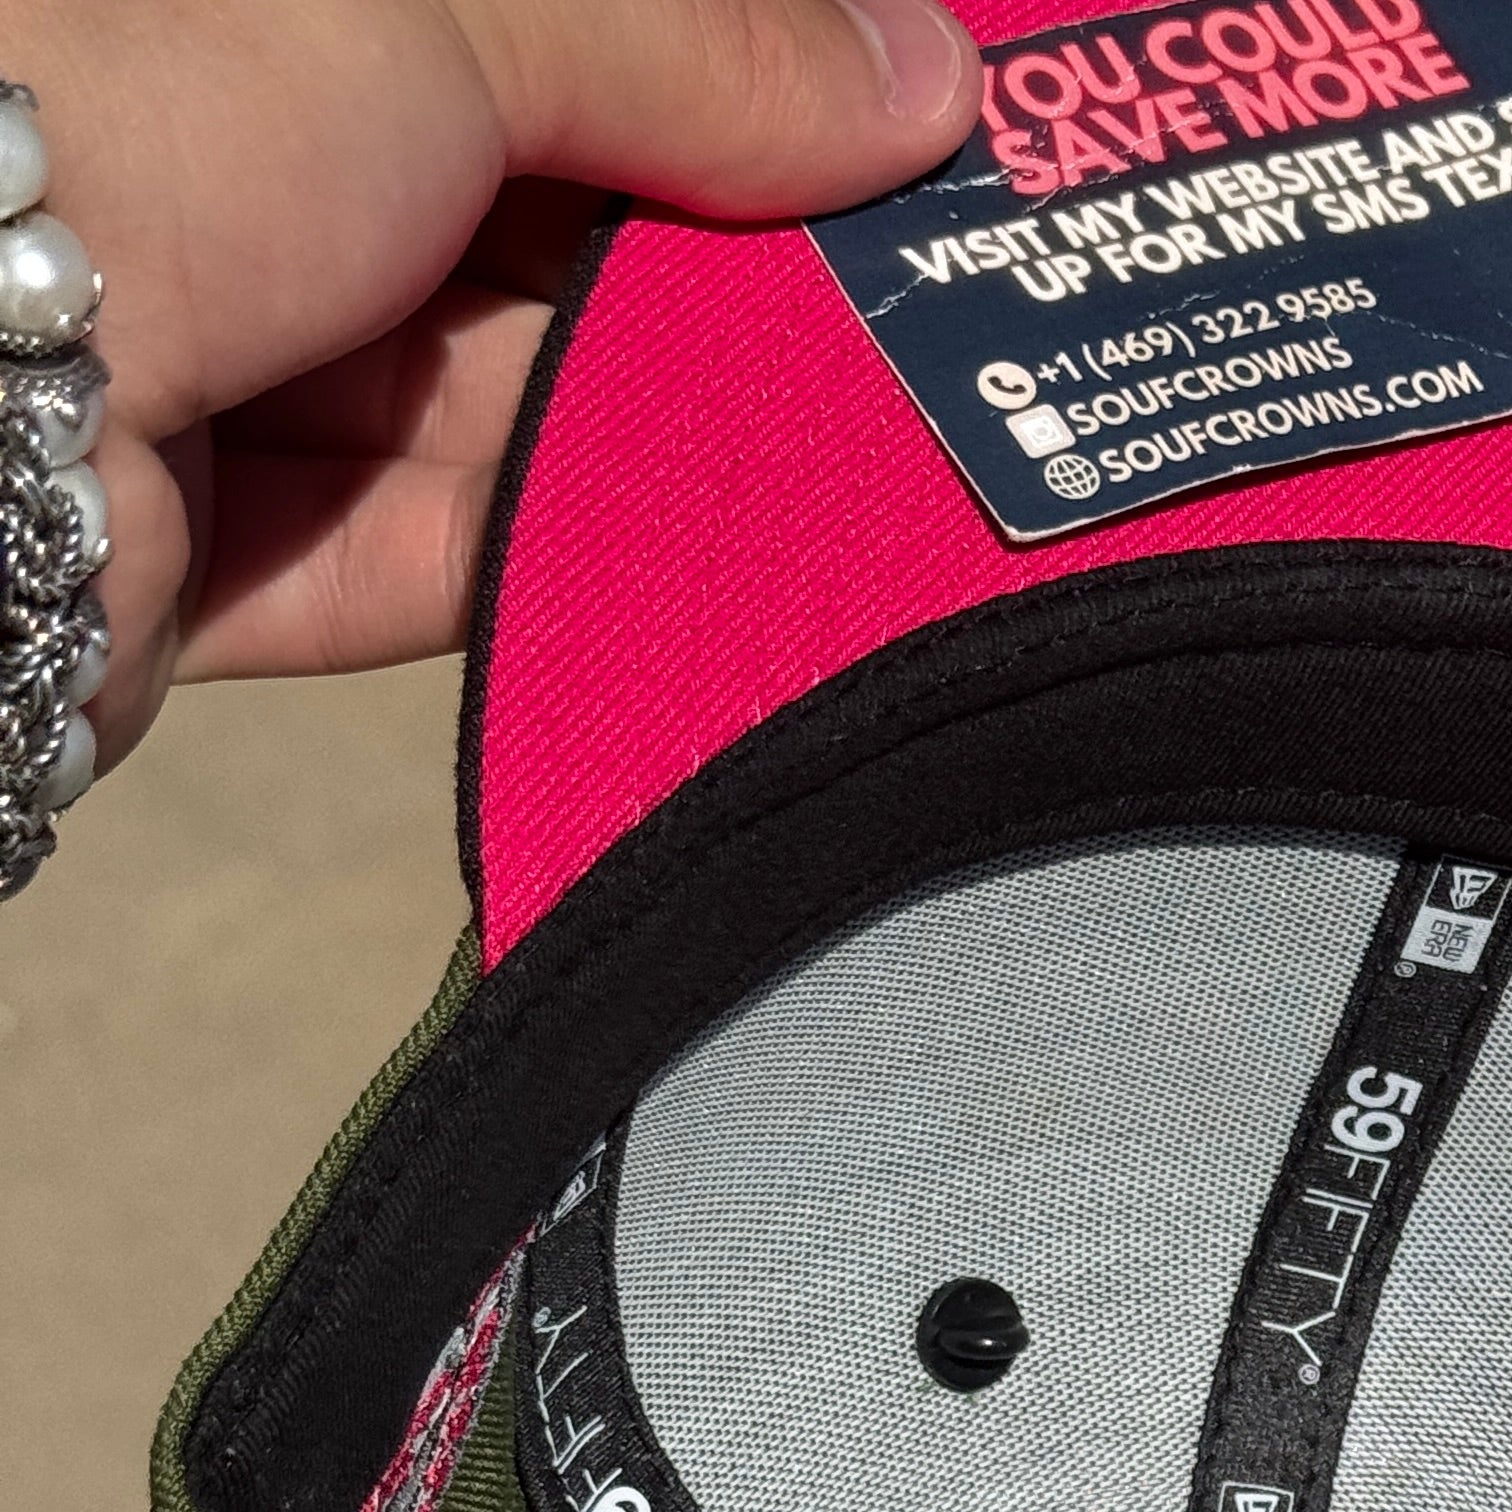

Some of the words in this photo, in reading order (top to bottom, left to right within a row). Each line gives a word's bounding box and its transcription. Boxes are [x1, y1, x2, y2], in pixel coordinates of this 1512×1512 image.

[979, 34, 1141, 132] YOU
[1145, 0, 1424, 84] COULD
[991, 89, 1229, 196] SAVE
[1219, 33, 1472, 139] MORE
[900, 218, 1052, 284] VISIT
[1051, 192, 1145, 250] MY
[1143, 138, 1382, 220] WEBSITE
[1382, 112, 1496, 174] AND
[1010, 254, 1092, 302] UP
[1095, 223, 1227, 283] FOR
[1217, 199, 1306, 254] MY
[1312, 177, 1431, 234] SMS
[1037, 351, 1083, 387] +1
[1081, 322, 1196, 382] (469)
[1192, 301, 1281, 345] 322
[1276, 277, 1378, 324] 9585
[1065, 337, 1354, 437] SOUFCROWNS
[1098, 360, 1485, 483] SOUFCROWNS.COM
[1443, 923, 1474, 962] NEW
